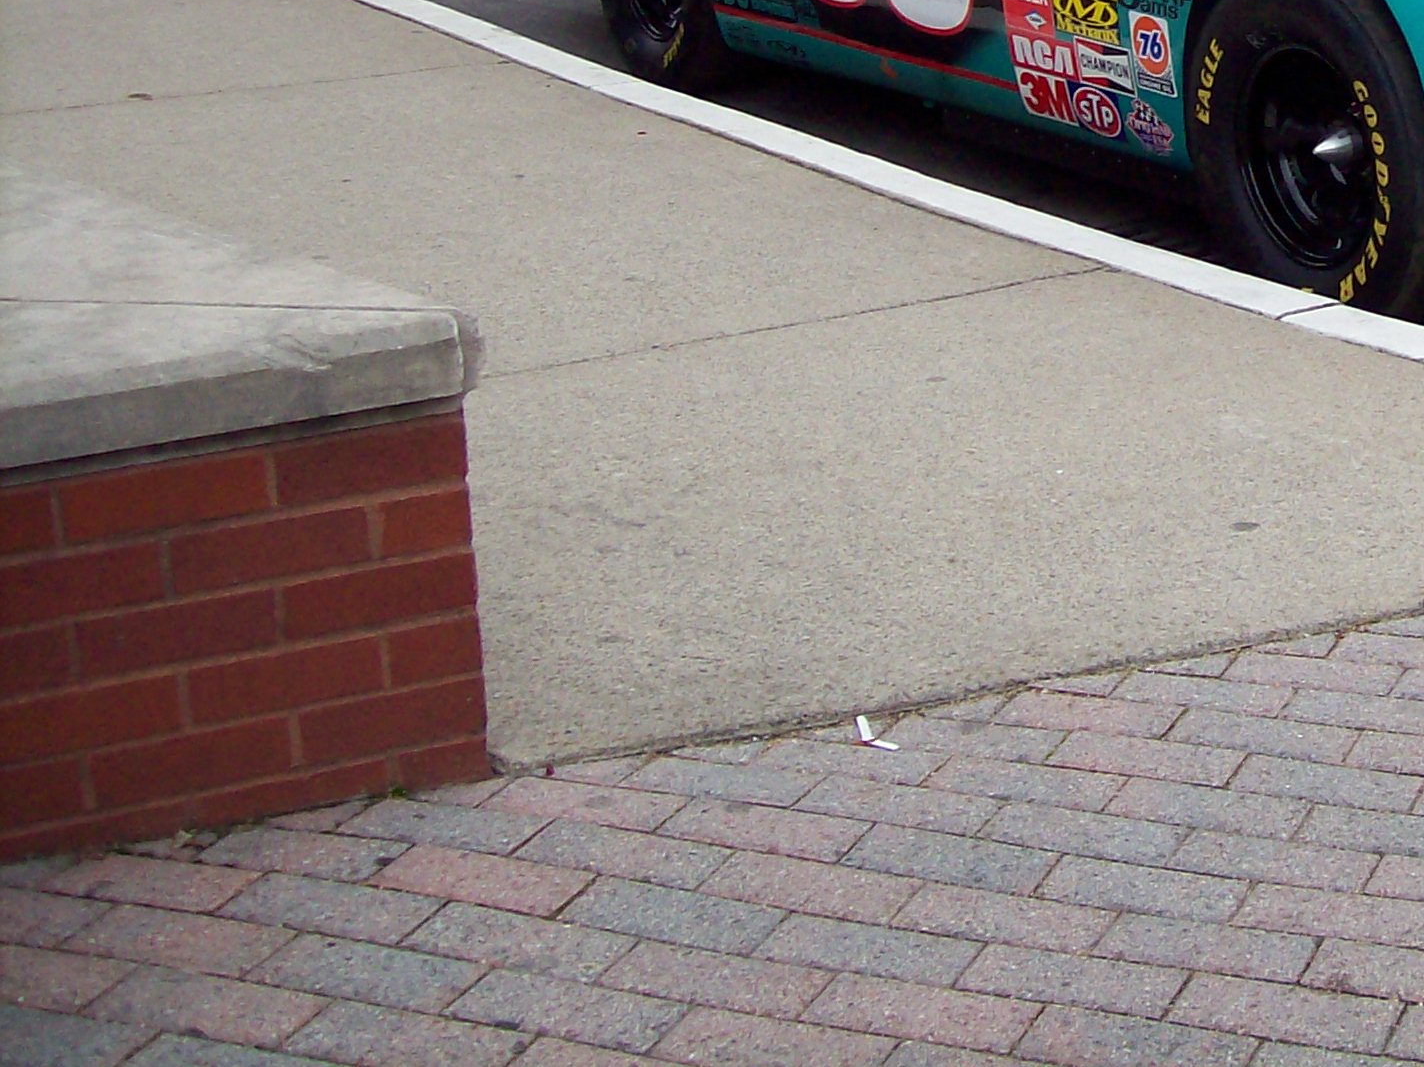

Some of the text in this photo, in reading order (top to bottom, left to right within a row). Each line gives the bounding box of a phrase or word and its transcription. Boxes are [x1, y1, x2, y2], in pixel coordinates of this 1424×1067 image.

[1011, 34, 1075, 76] RCA
[1137, 30, 1164, 62] 76
[1081, 53, 1130, 78] CHAMPION
[1195, 38, 1225, 125] EAGLE
[1020, 72, 1077, 122] 3M
[1080, 94, 1113, 128] STP
